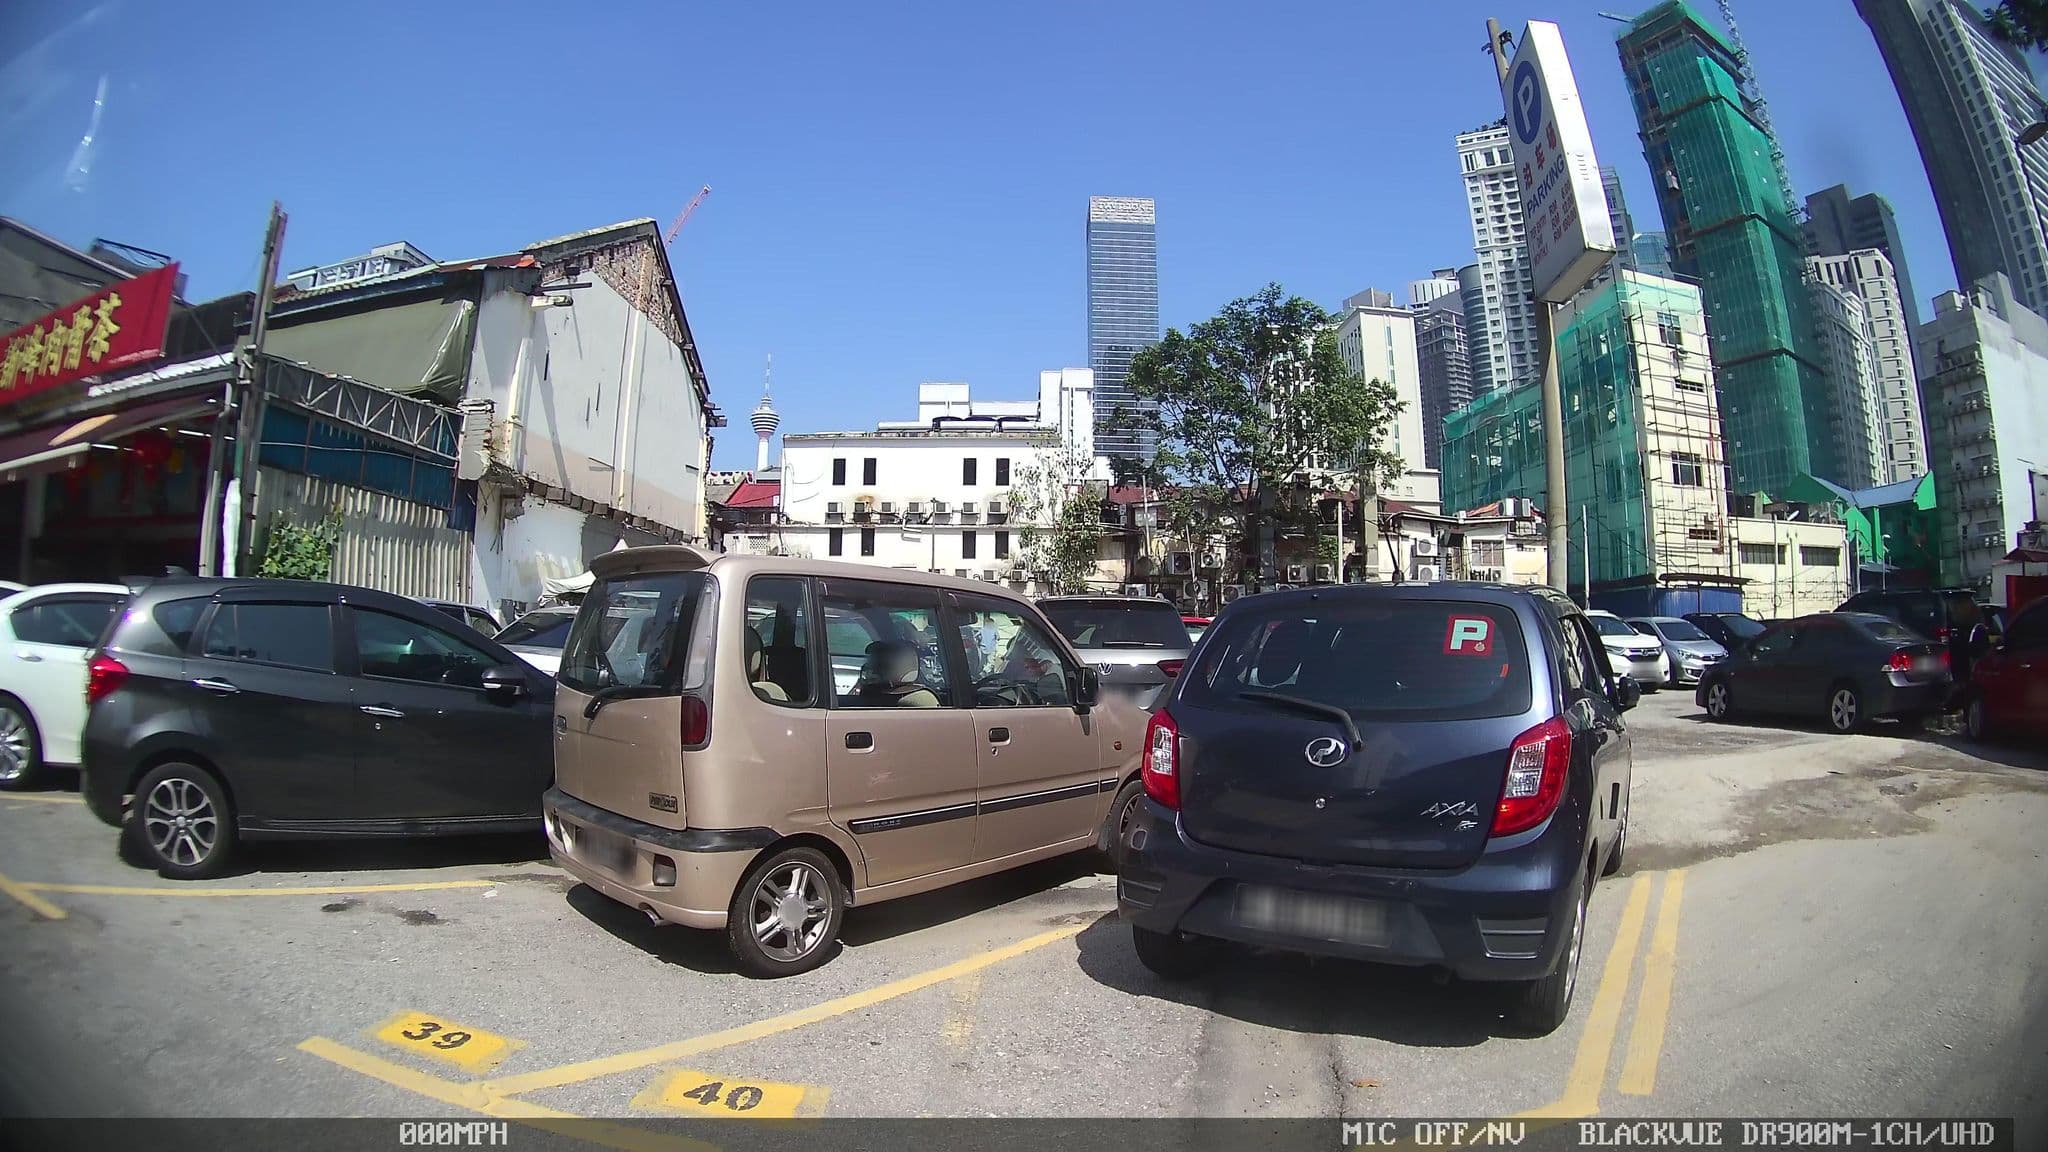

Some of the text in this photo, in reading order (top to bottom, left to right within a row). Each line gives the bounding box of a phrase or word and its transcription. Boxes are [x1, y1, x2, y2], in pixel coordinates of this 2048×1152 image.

[1517, 75, 1534, 133] P
[1526, 153, 1565, 219] PARKING
[1450, 619, 1489, 651] P
[1420, 801, 1479, 818] AXIA
[401, 1021, 473, 1050] 39
[683, 1080, 764, 1112] 40
